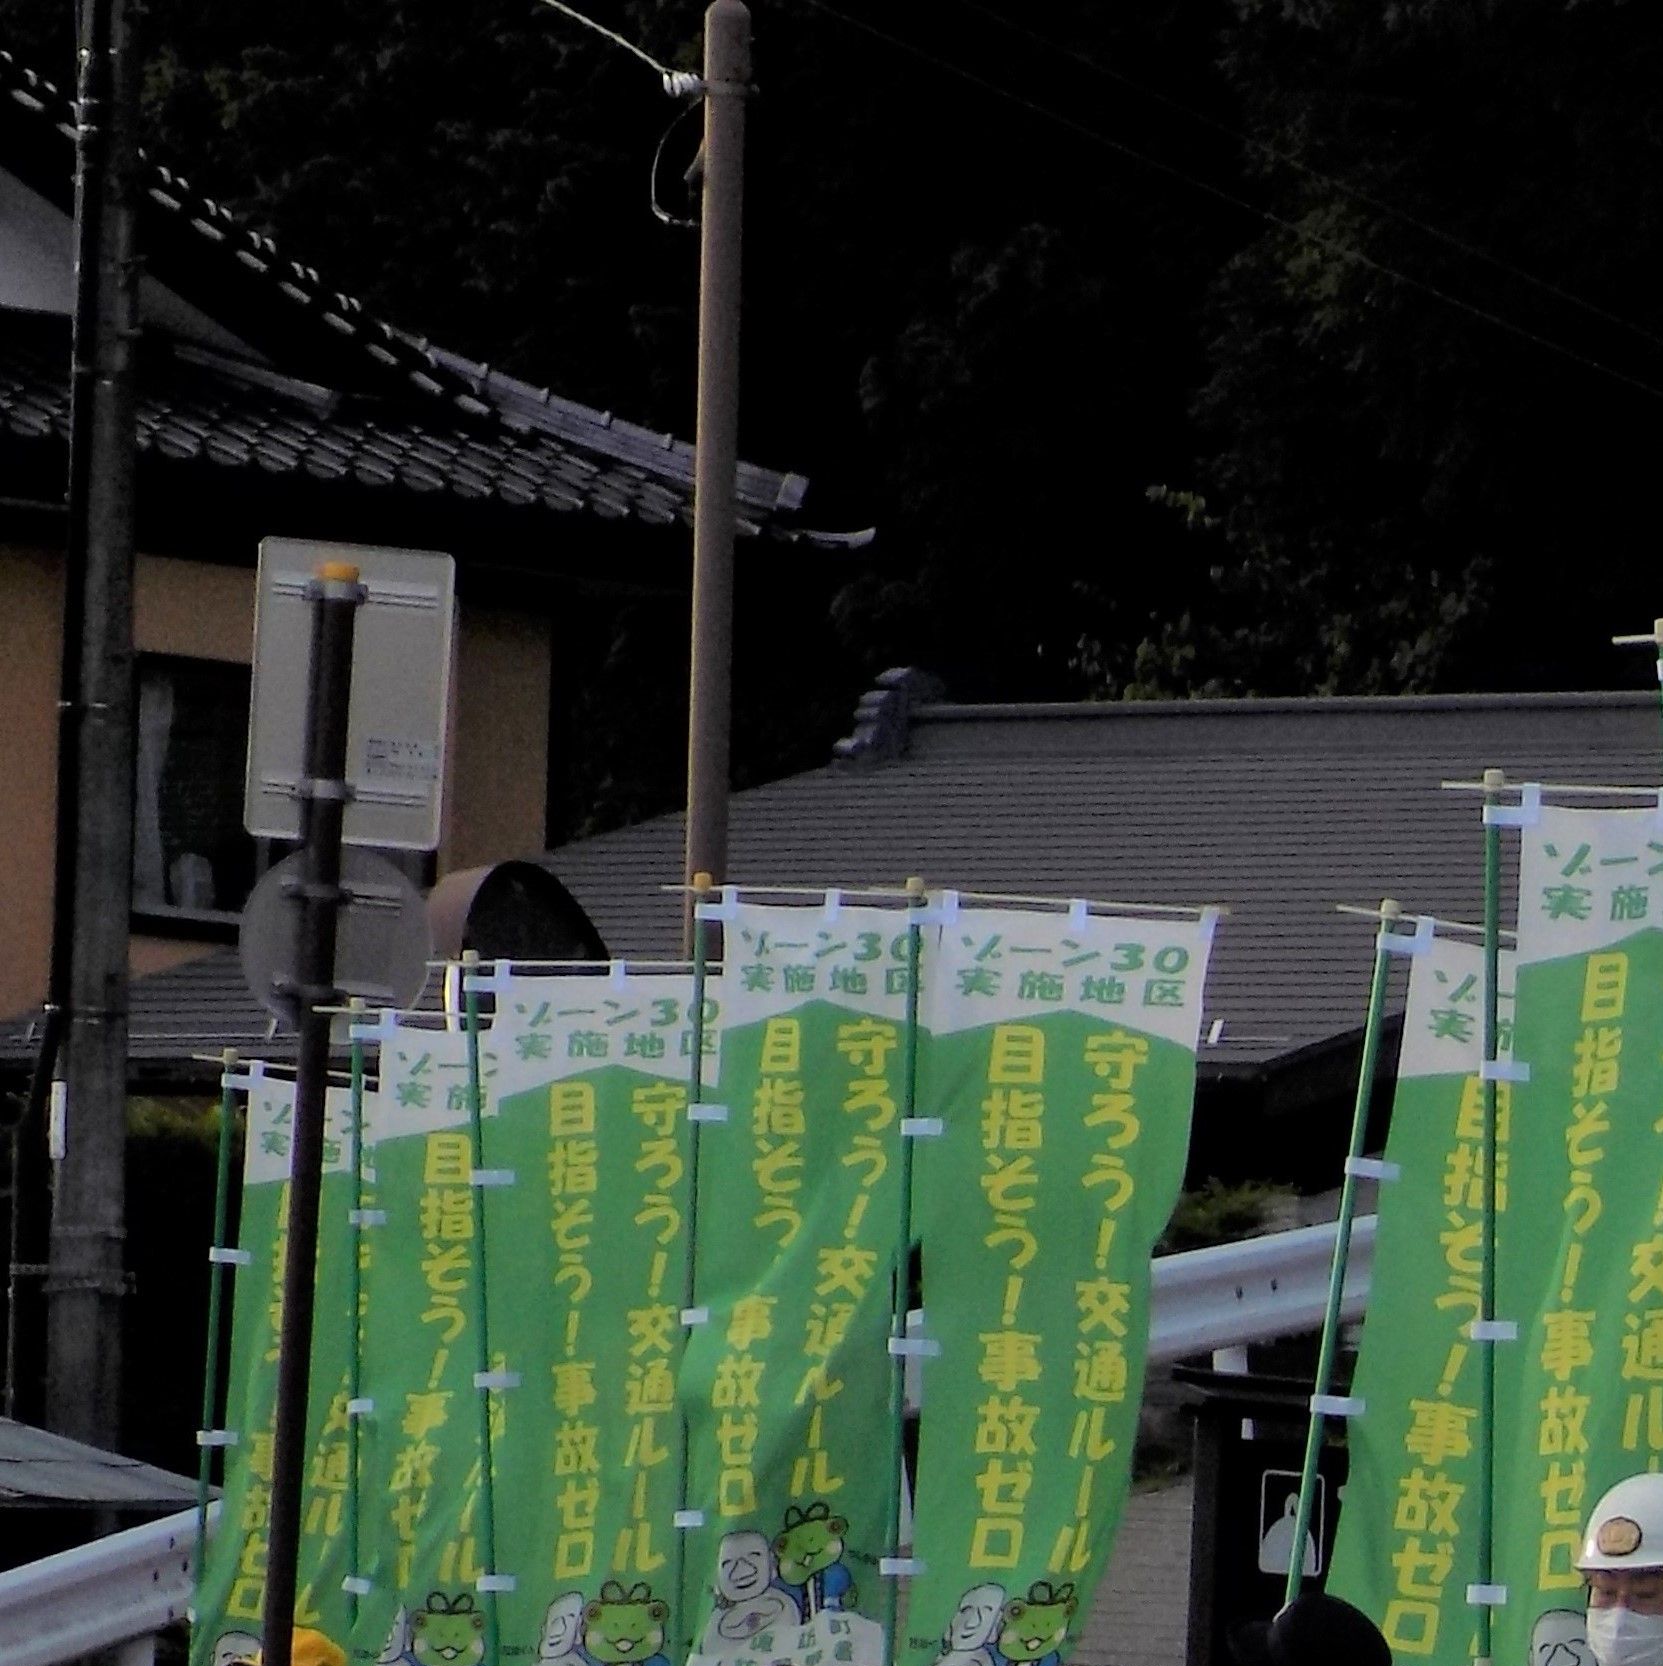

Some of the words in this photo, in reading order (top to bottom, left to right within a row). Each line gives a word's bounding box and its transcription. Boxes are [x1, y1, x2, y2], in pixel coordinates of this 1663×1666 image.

[514, 1029, 719, 1059] 実施地区
[515, 997, 720, 1028] ゾーン30
[956, 967, 1186, 1007] 実施地区
[961, 933, 1189, 974] ゾーン30
[547, 1080, 601, 1580] 目指そう！事故ゼロ
[612, 1081, 686, 1573] 守ろう！交通ルール
[712, 1015, 806, 1517] 目指そう事故ゼロ
[969, 1023, 1046, 1569] 目指そう！事故ゼロ
[1047, 1030, 1150, 1574] 守ろう！交通ルール
